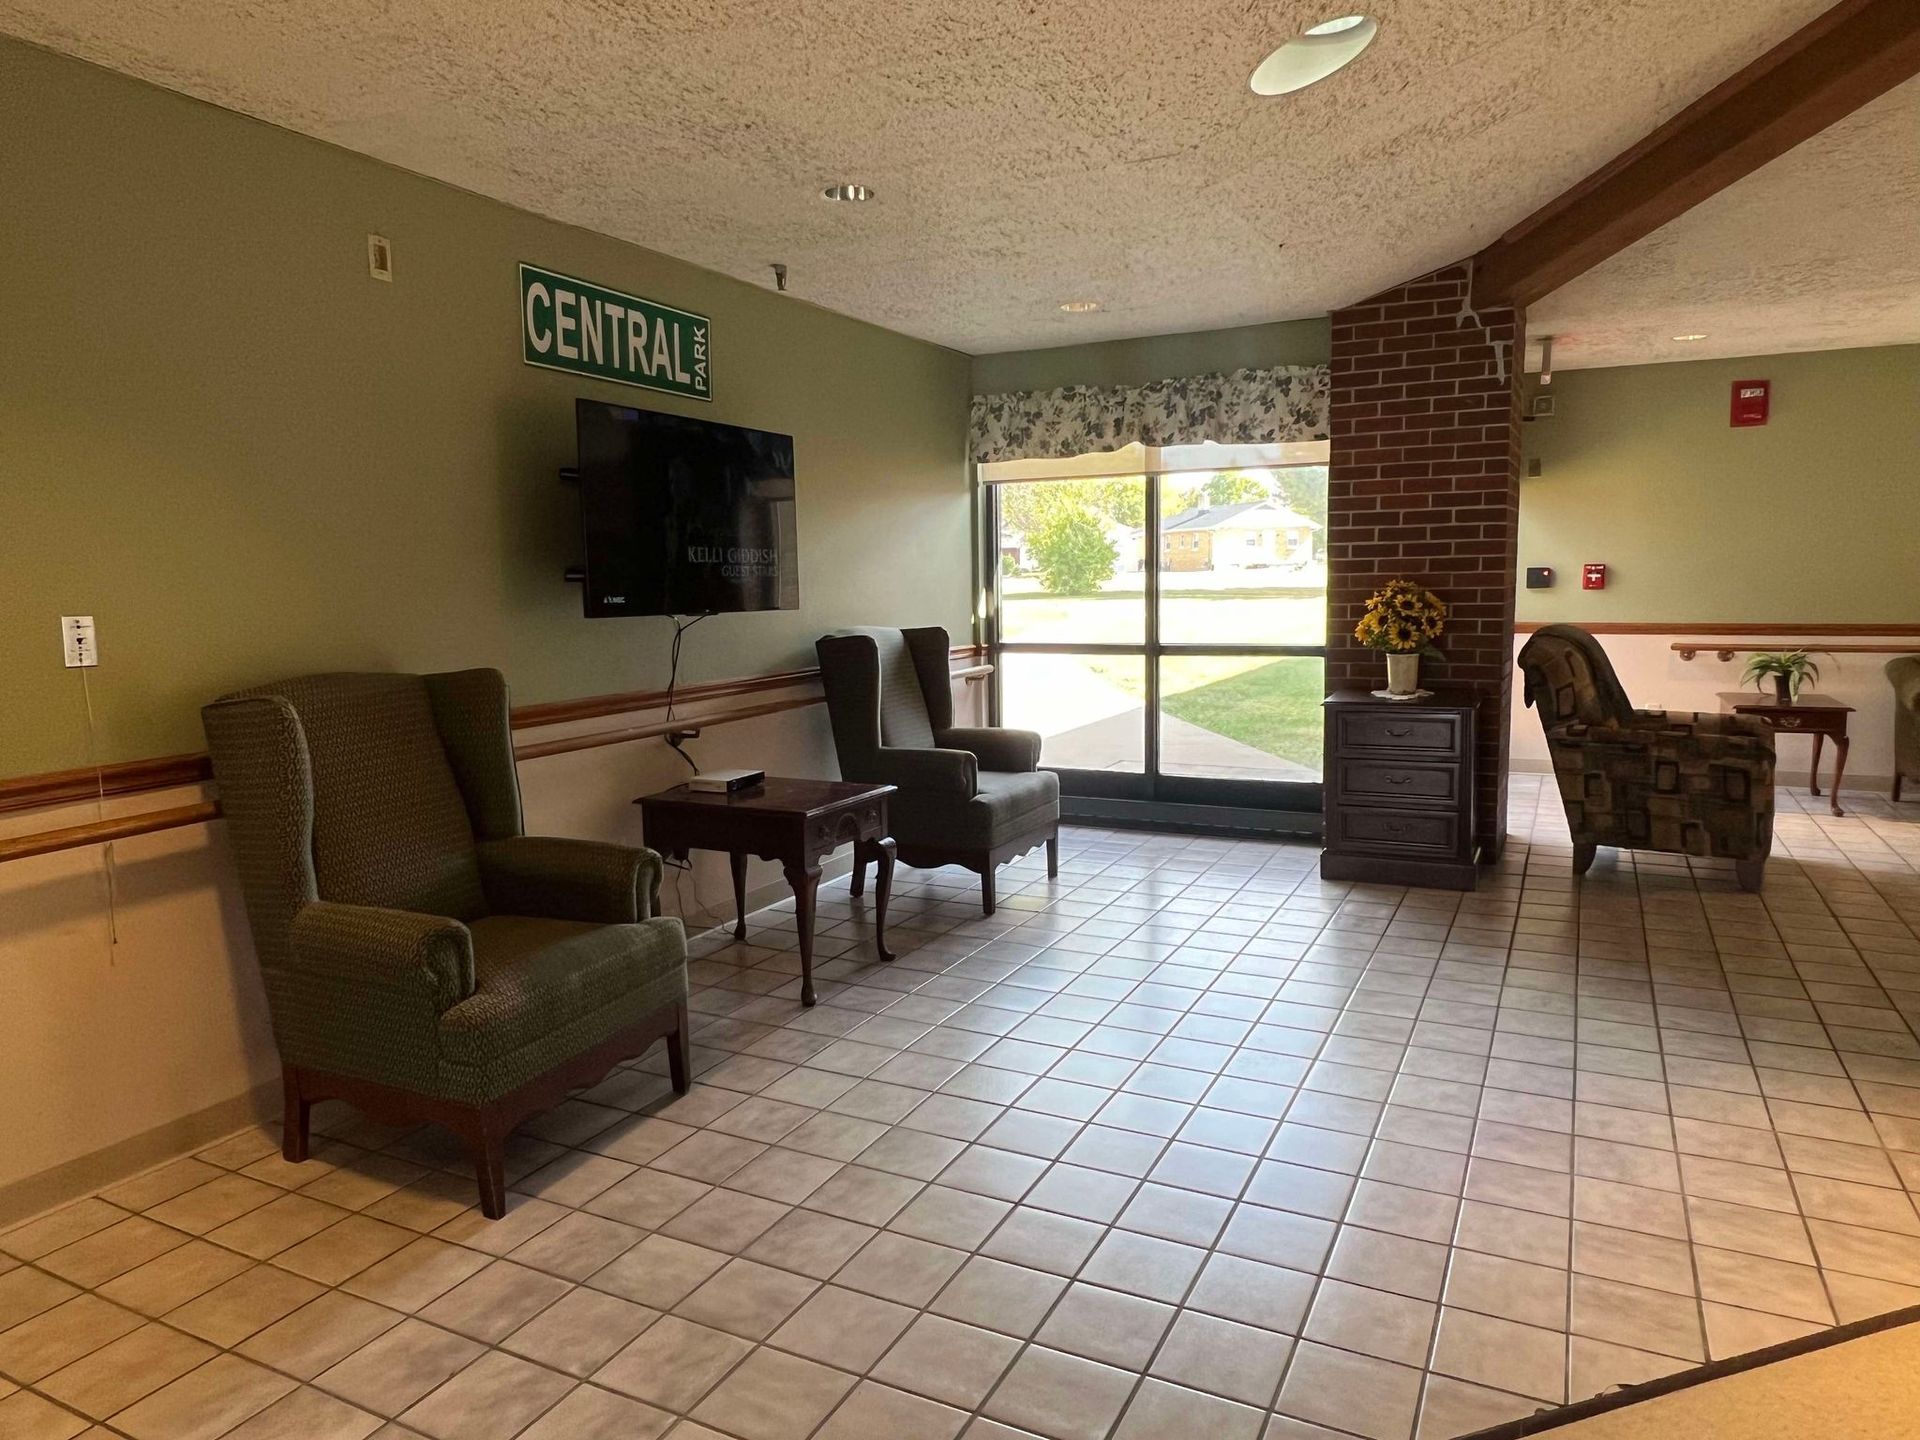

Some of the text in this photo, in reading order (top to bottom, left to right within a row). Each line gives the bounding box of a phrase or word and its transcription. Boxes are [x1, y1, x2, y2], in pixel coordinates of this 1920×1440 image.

[526, 281, 691, 384] CENTRAL
[693, 325, 707, 391] PARK
[687, 546, 778, 564] KELLI GIDDISH
